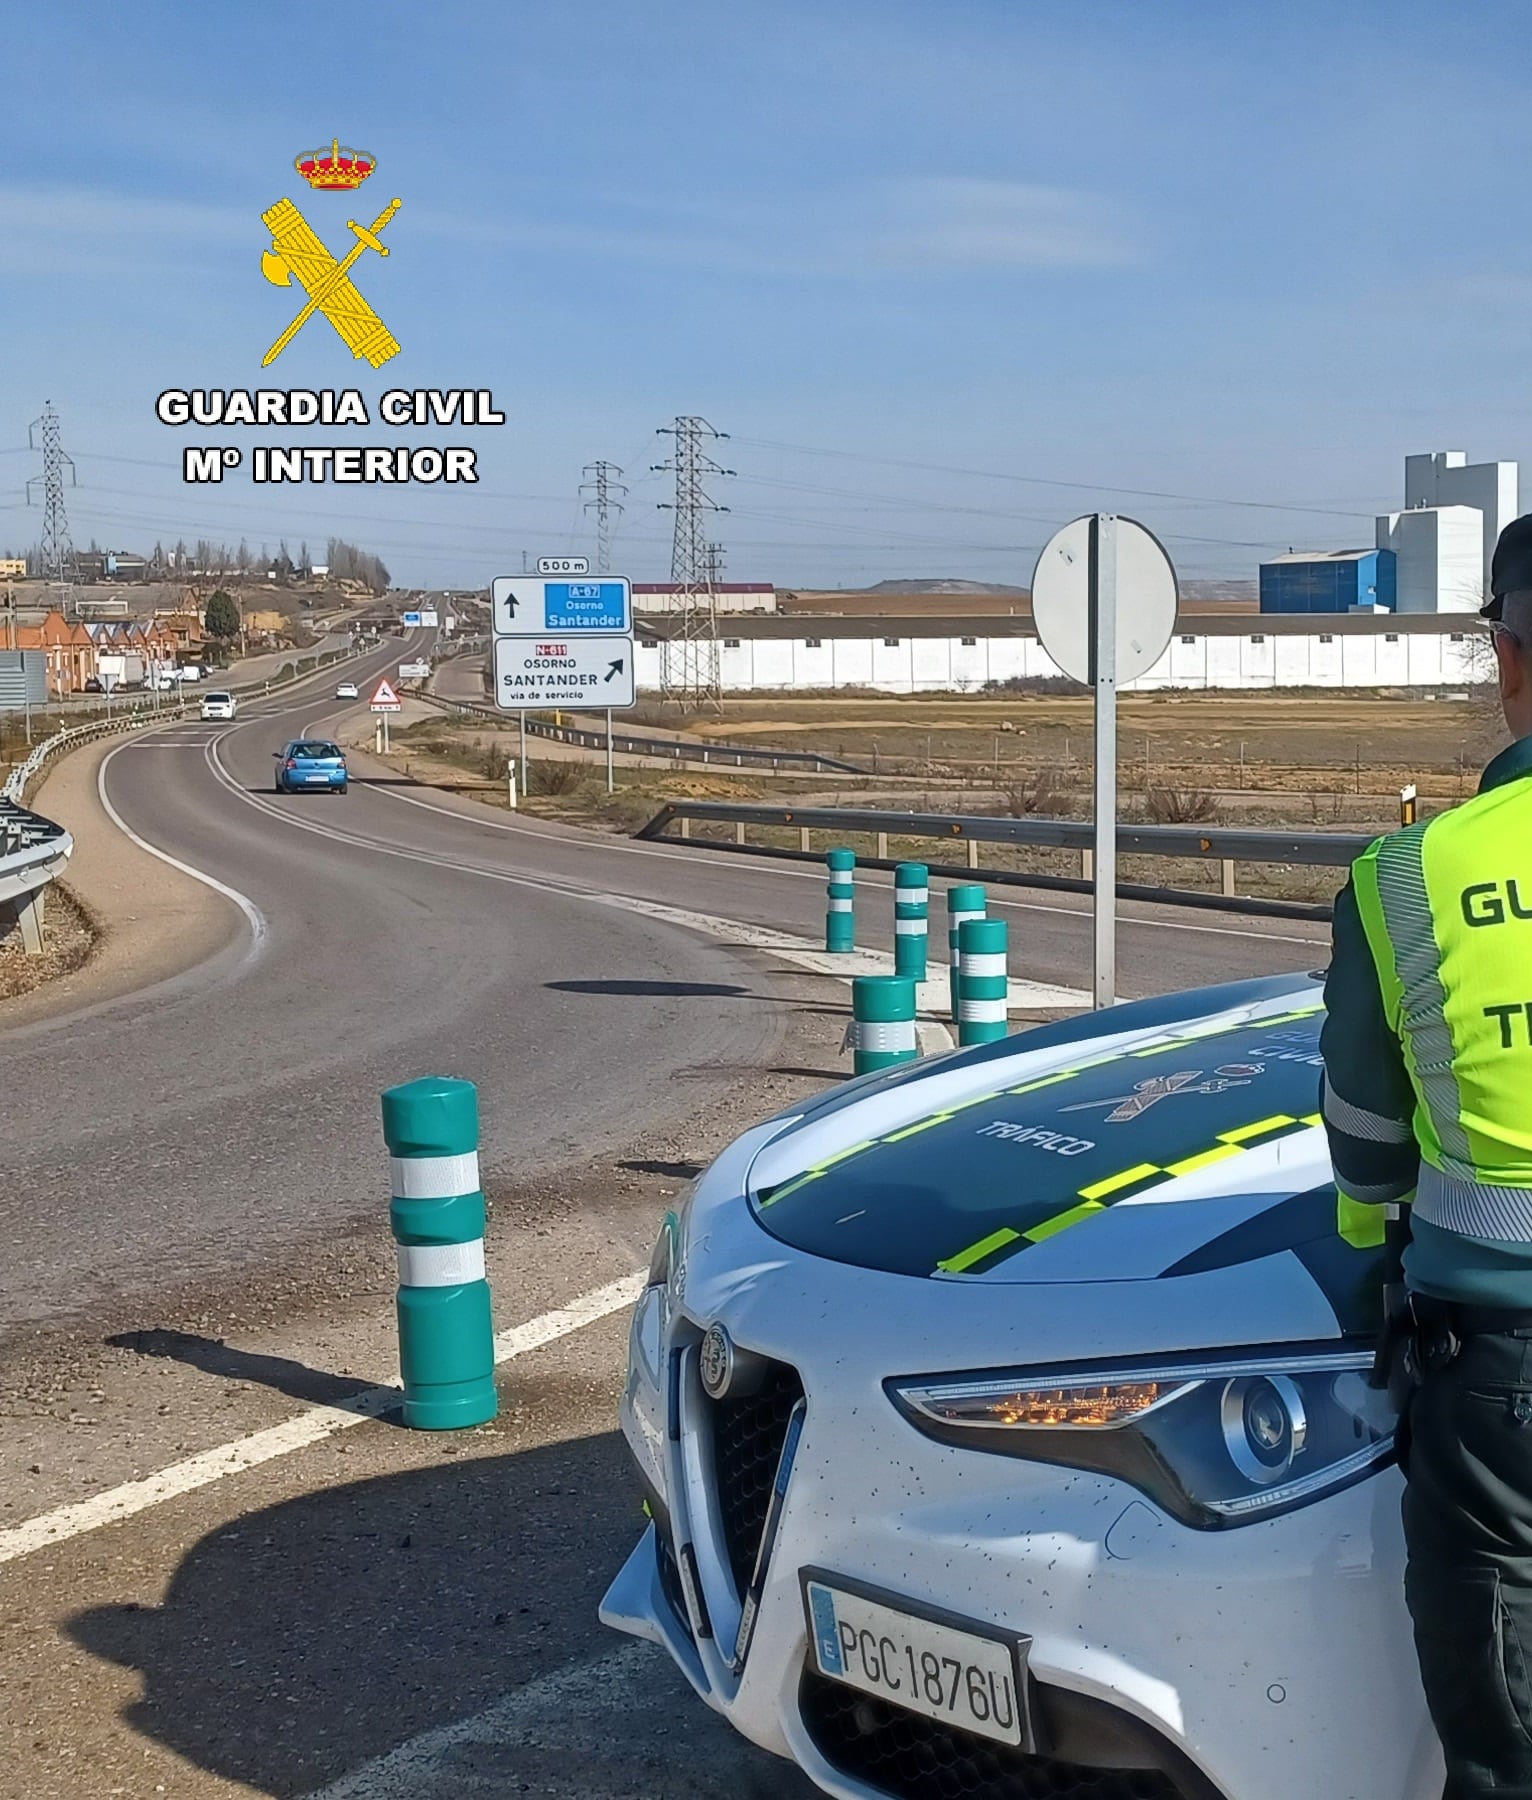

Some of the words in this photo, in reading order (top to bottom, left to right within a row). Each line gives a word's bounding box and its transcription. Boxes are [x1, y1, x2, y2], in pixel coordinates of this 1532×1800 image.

[542, 561, 570, 571] 500
[574, 563, 585, 571] m
[571, 586, 598, 597] A-67
[566, 601, 604, 610] Osorno
[548, 615, 622, 626] Santander
[536, 645, 567, 656] N-611
[524, 659, 576, 669] OSORNO
[503, 674, 598, 687] SANTANDER
[528, 690, 541, 700] de
[545, 690, 584, 700] servicio
[976, 1120, 1096, 1156] TRÁFICO
[823, 1640, 835, 1660] E
[837, 1621, 1013, 1729] PGC1876U
